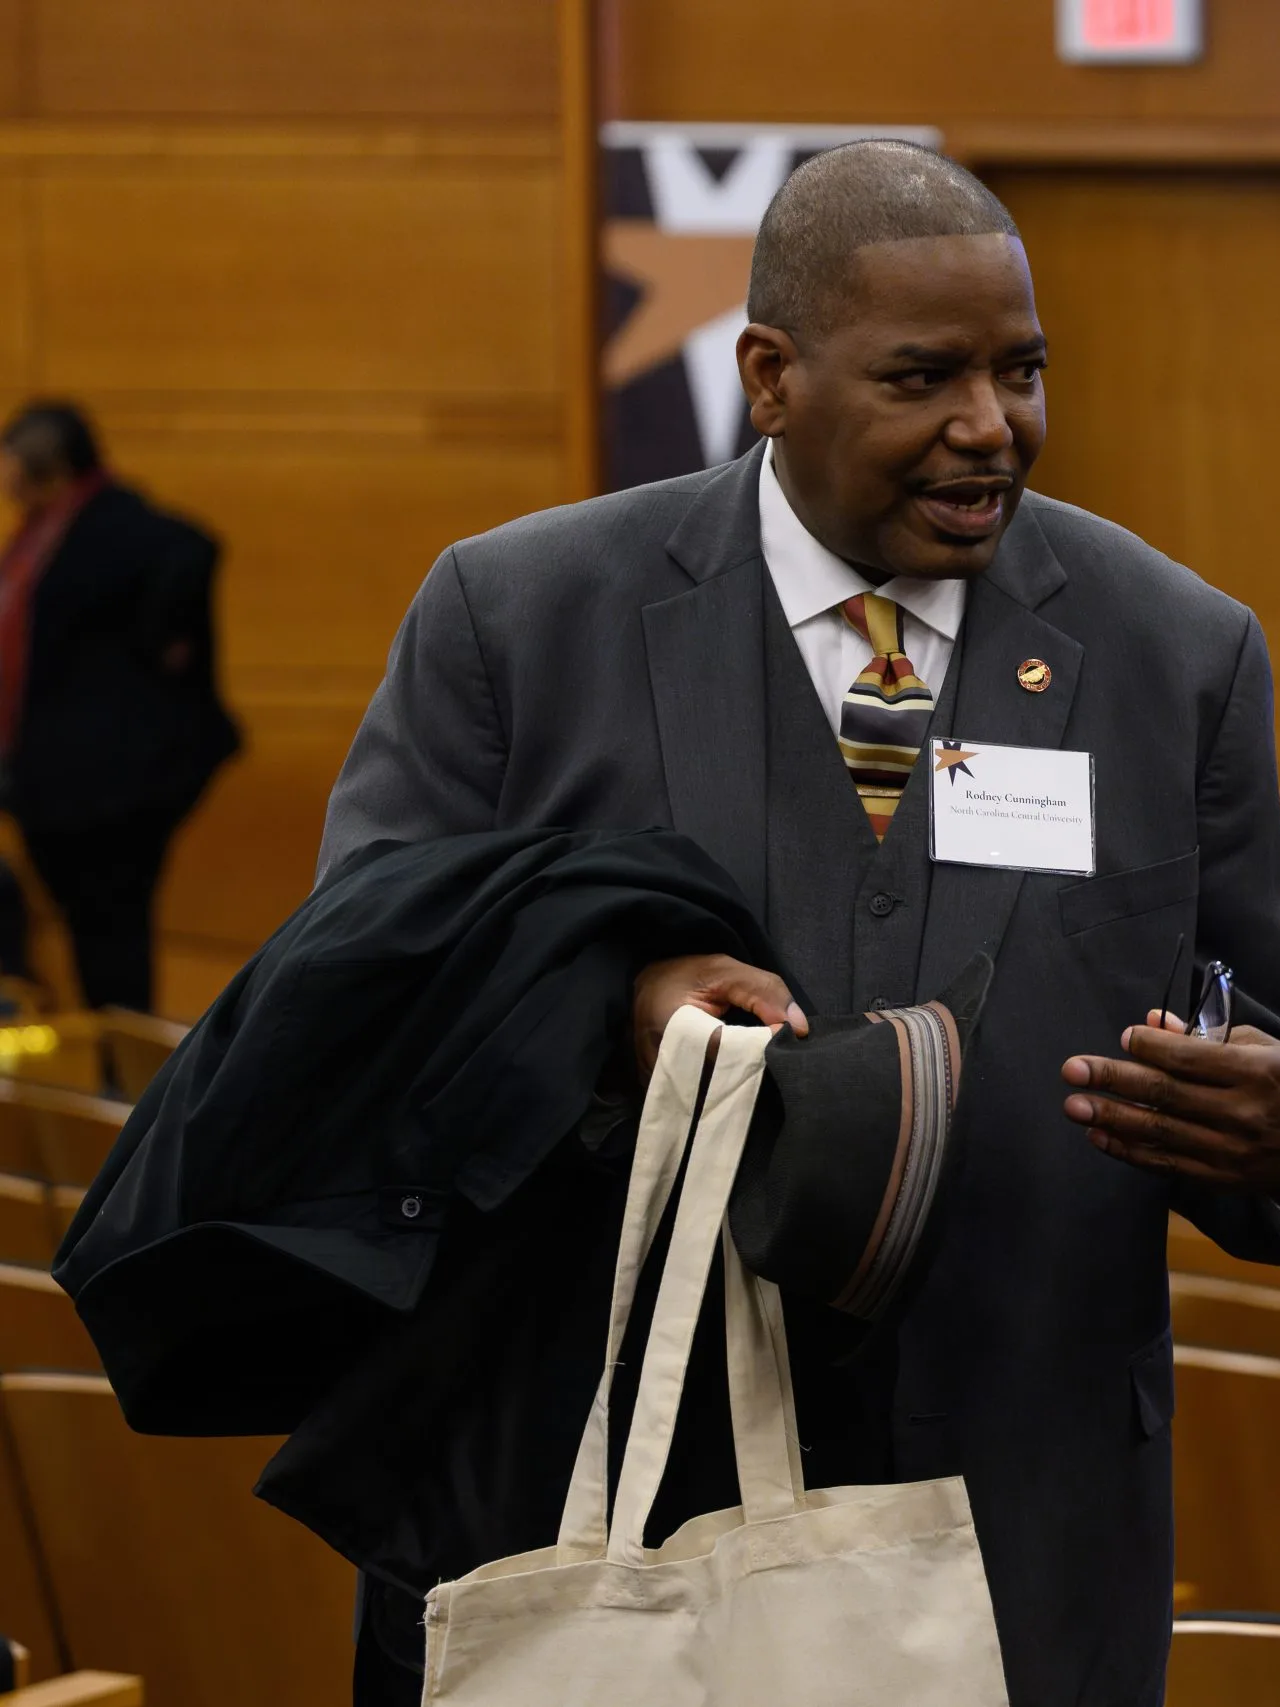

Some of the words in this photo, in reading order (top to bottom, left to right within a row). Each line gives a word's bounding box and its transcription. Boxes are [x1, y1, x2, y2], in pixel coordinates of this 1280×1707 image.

[966, 790, 1002, 804] Rodney
[1004, 793, 1067, 808] Cunningham
[950, 805, 974, 815] North
[975, 808, 1010, 818] Carolina
[1011, 811, 1041, 821] Central
[1043, 813, 1084, 825] University
